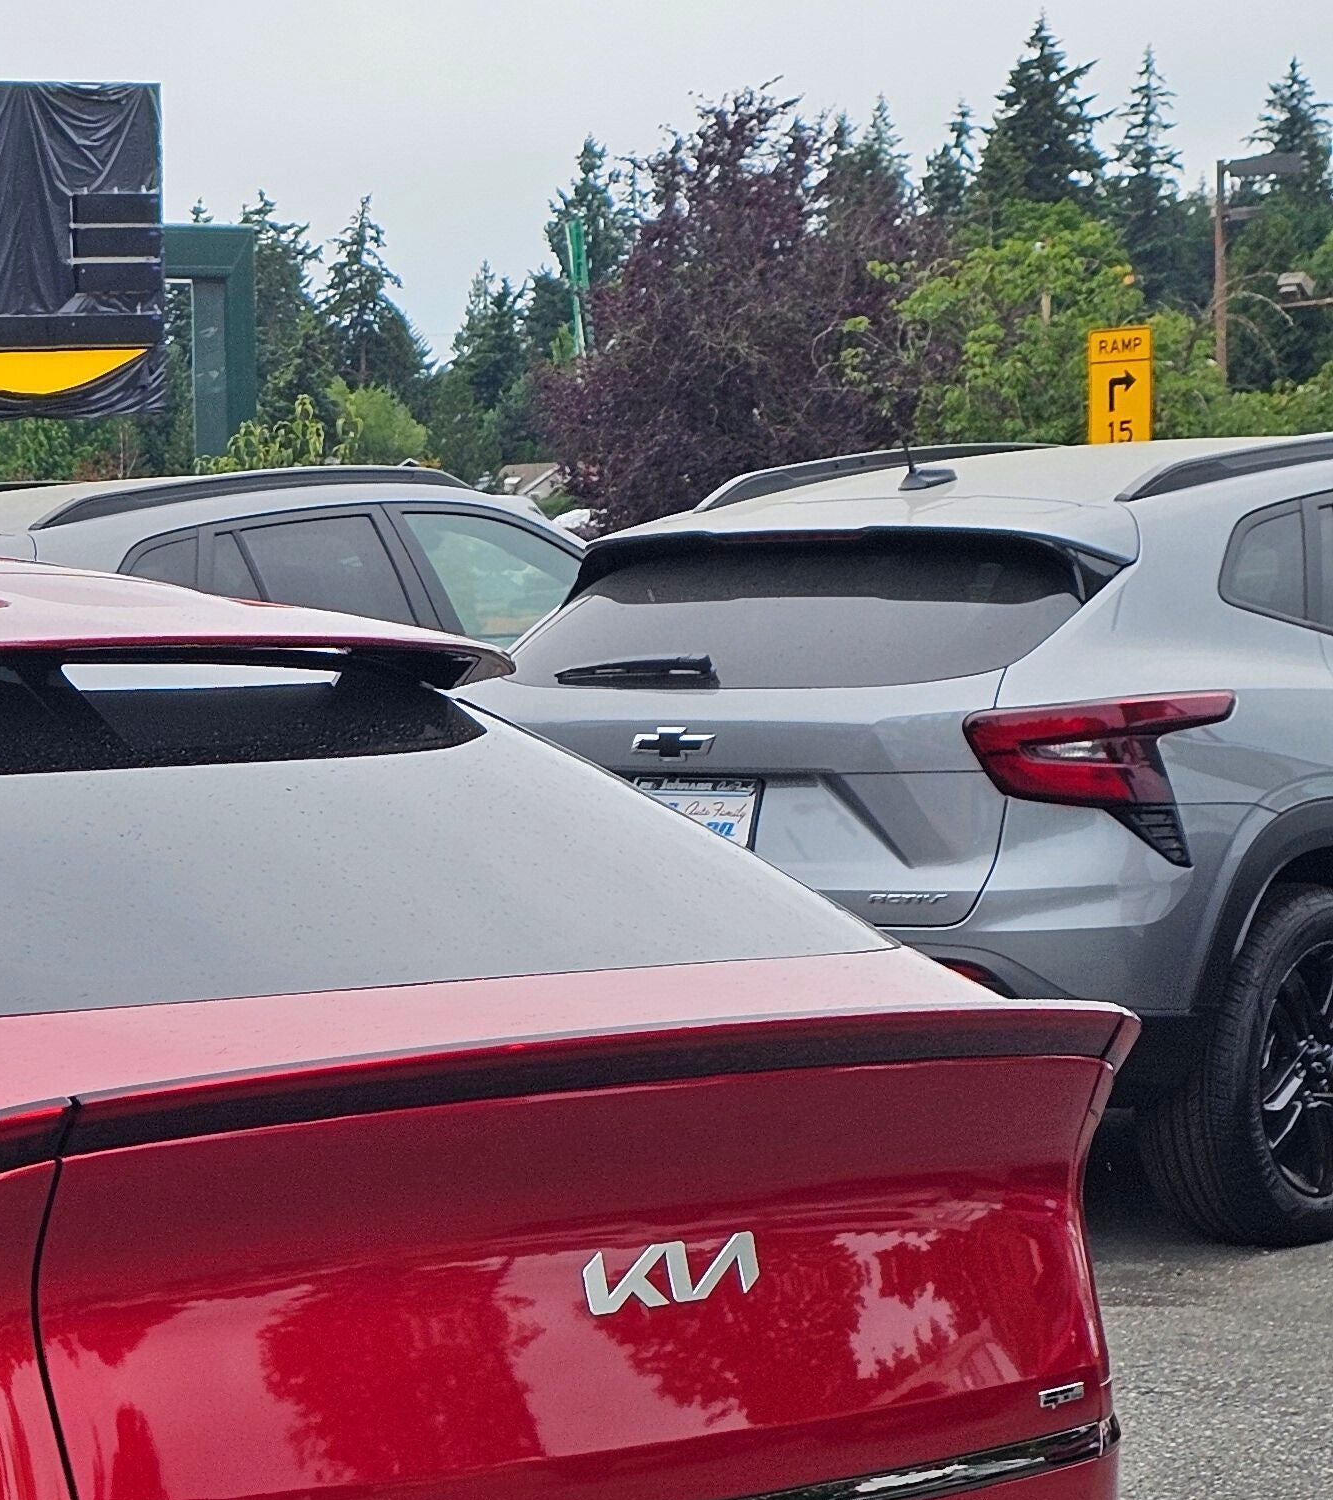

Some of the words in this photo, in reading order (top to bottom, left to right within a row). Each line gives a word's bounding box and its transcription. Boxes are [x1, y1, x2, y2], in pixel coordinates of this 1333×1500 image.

[1098, 337, 1142, 354] RAMP
[1108, 420, 1133, 443] 15
[583, 1231, 760, 1315] KIA
